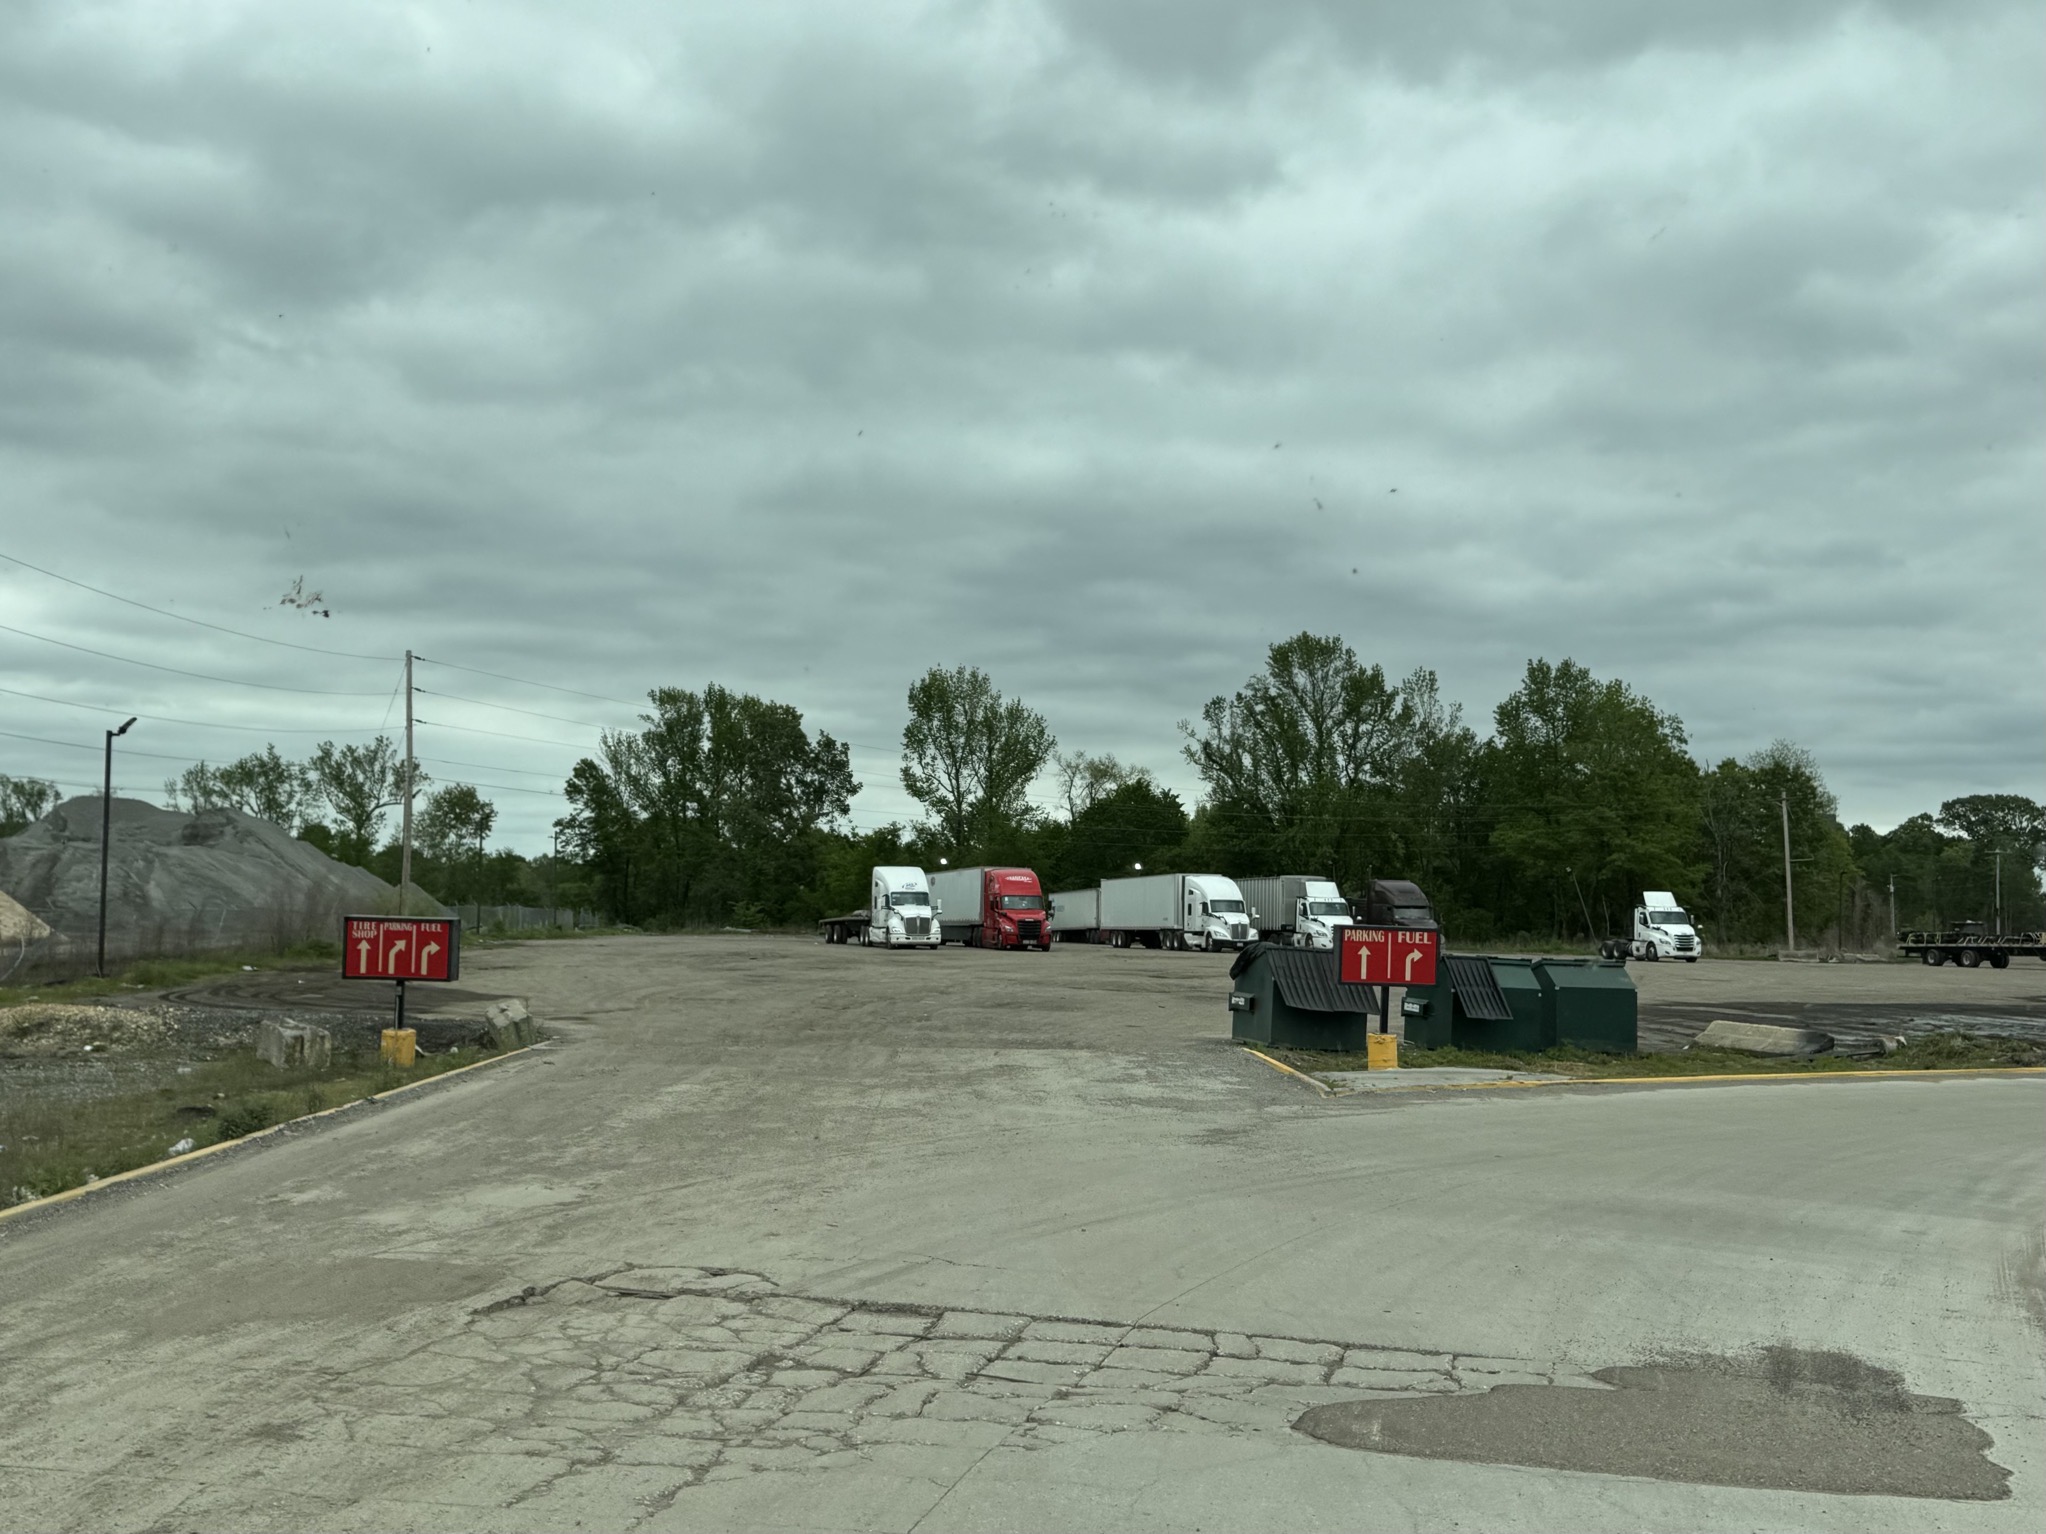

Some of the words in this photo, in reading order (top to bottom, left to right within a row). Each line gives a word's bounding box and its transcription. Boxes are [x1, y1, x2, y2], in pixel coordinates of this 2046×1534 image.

[352, 921, 377, 930] TIRE
[384, 922, 413, 931] PARKING
[421, 923, 442, 932] FUEL
[352, 930, 377, 939] SHOP
[1344, 929, 1385, 942] PARKING
[1397, 931, 1432, 944] FUEL
